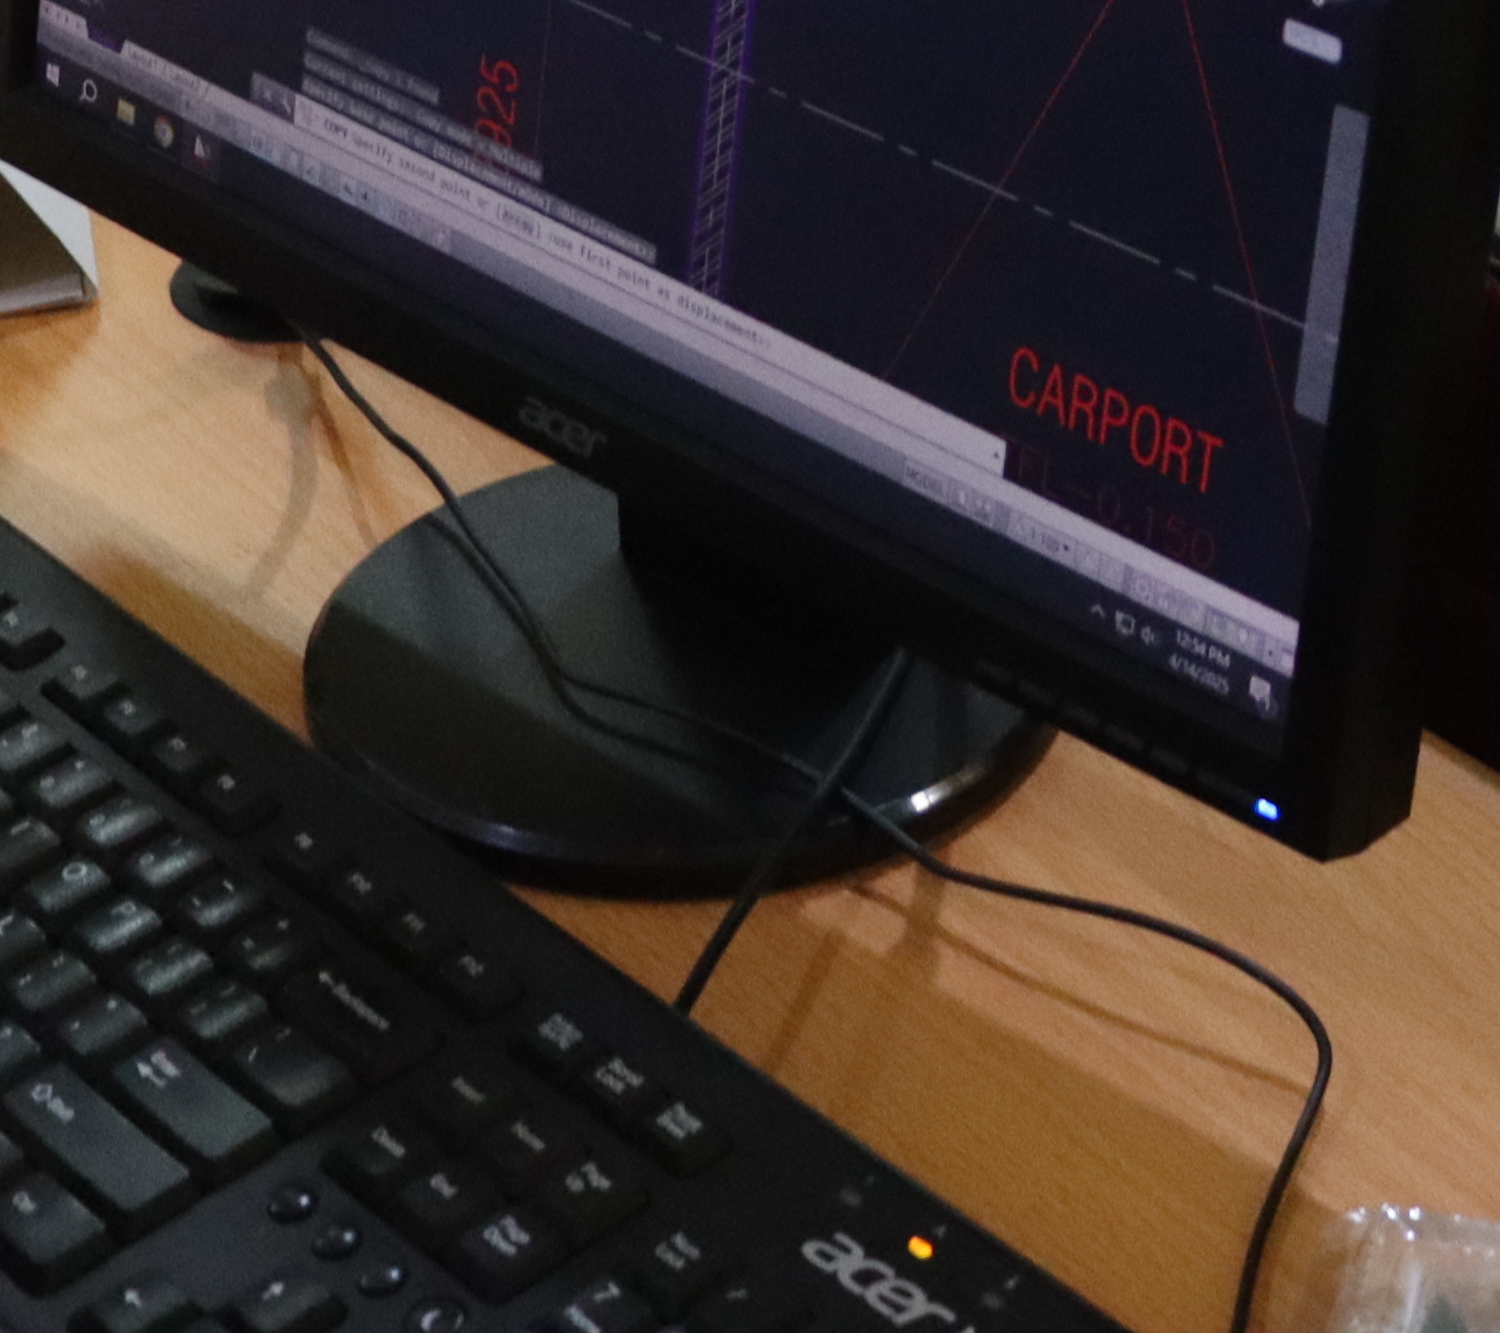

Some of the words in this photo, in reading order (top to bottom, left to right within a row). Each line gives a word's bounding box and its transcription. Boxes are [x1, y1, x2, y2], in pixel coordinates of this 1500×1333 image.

[517, 394, 609, 462] acer
[1008, 346, 1225, 494] CARPORT
[1208, 644, 1232, 670] PM
[800, 1231, 957, 1327] acer
